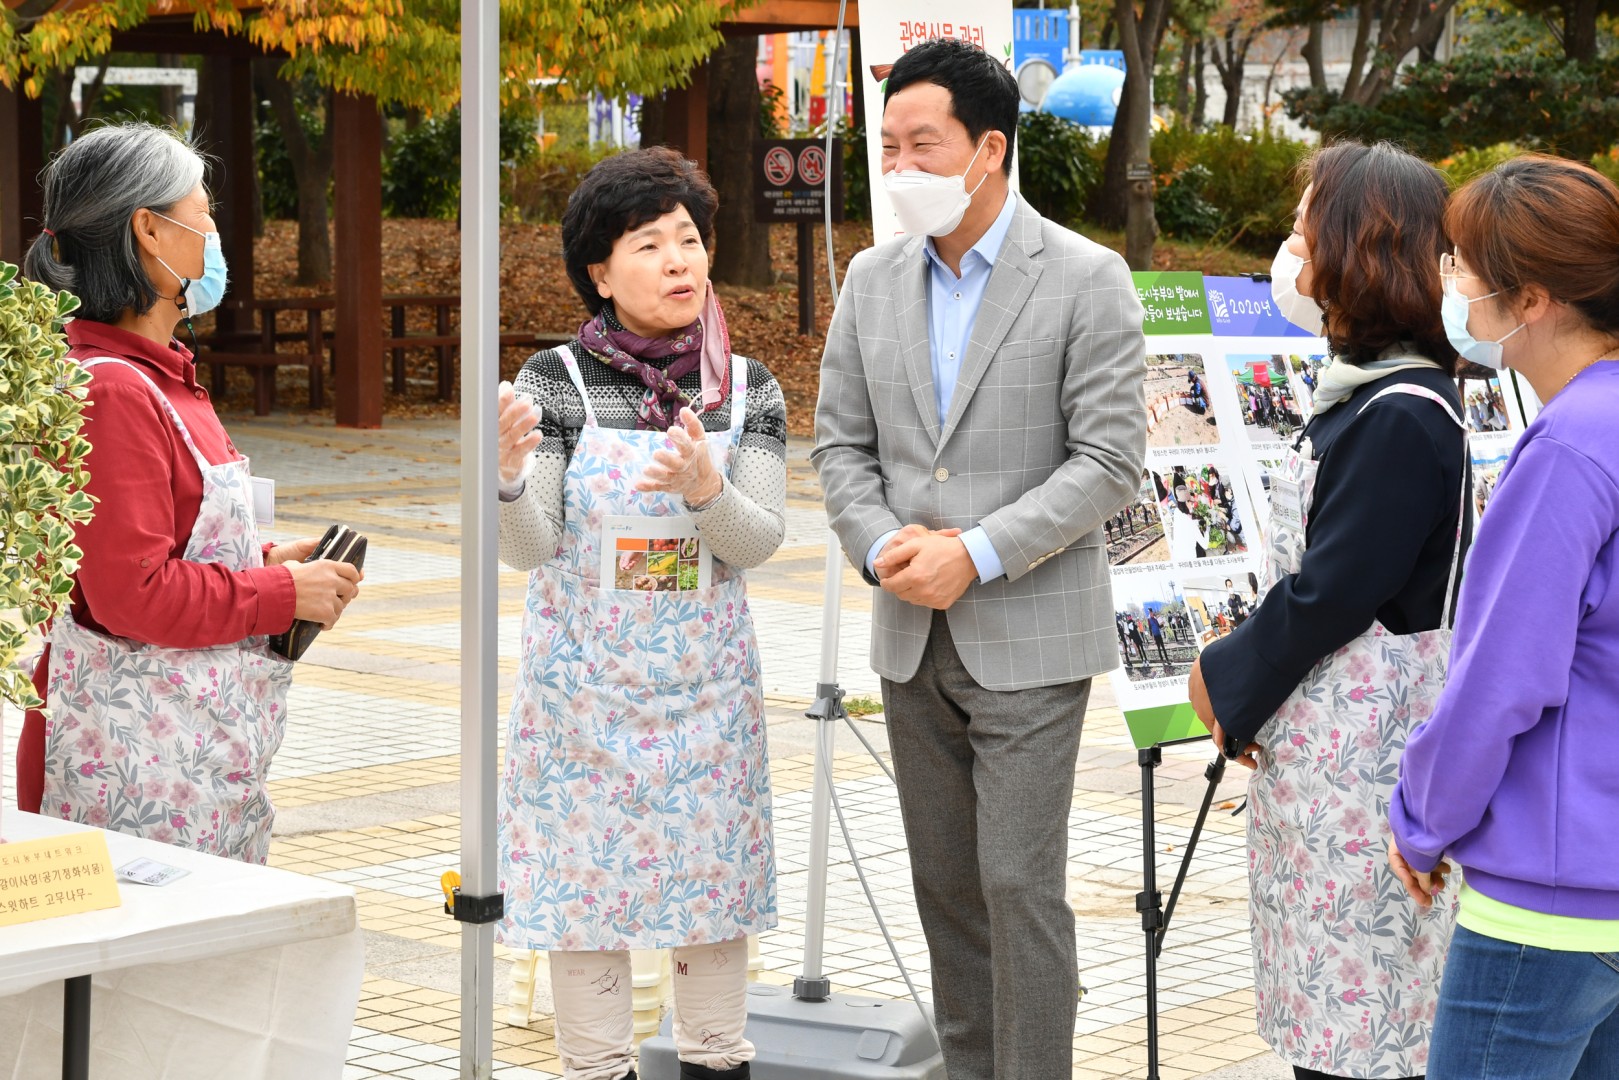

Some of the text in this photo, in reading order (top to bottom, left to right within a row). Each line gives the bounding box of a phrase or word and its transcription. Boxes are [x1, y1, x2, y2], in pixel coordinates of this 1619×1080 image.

[1137, 285, 1200, 302] 도시농부의 밭에서
[1165, 305, 1203, 322] 보냈습니다
[1229, 299, 1272, 317] 2020년
[567, 968, 586, 976] WEAR
[677, 961, 688, 976] M
